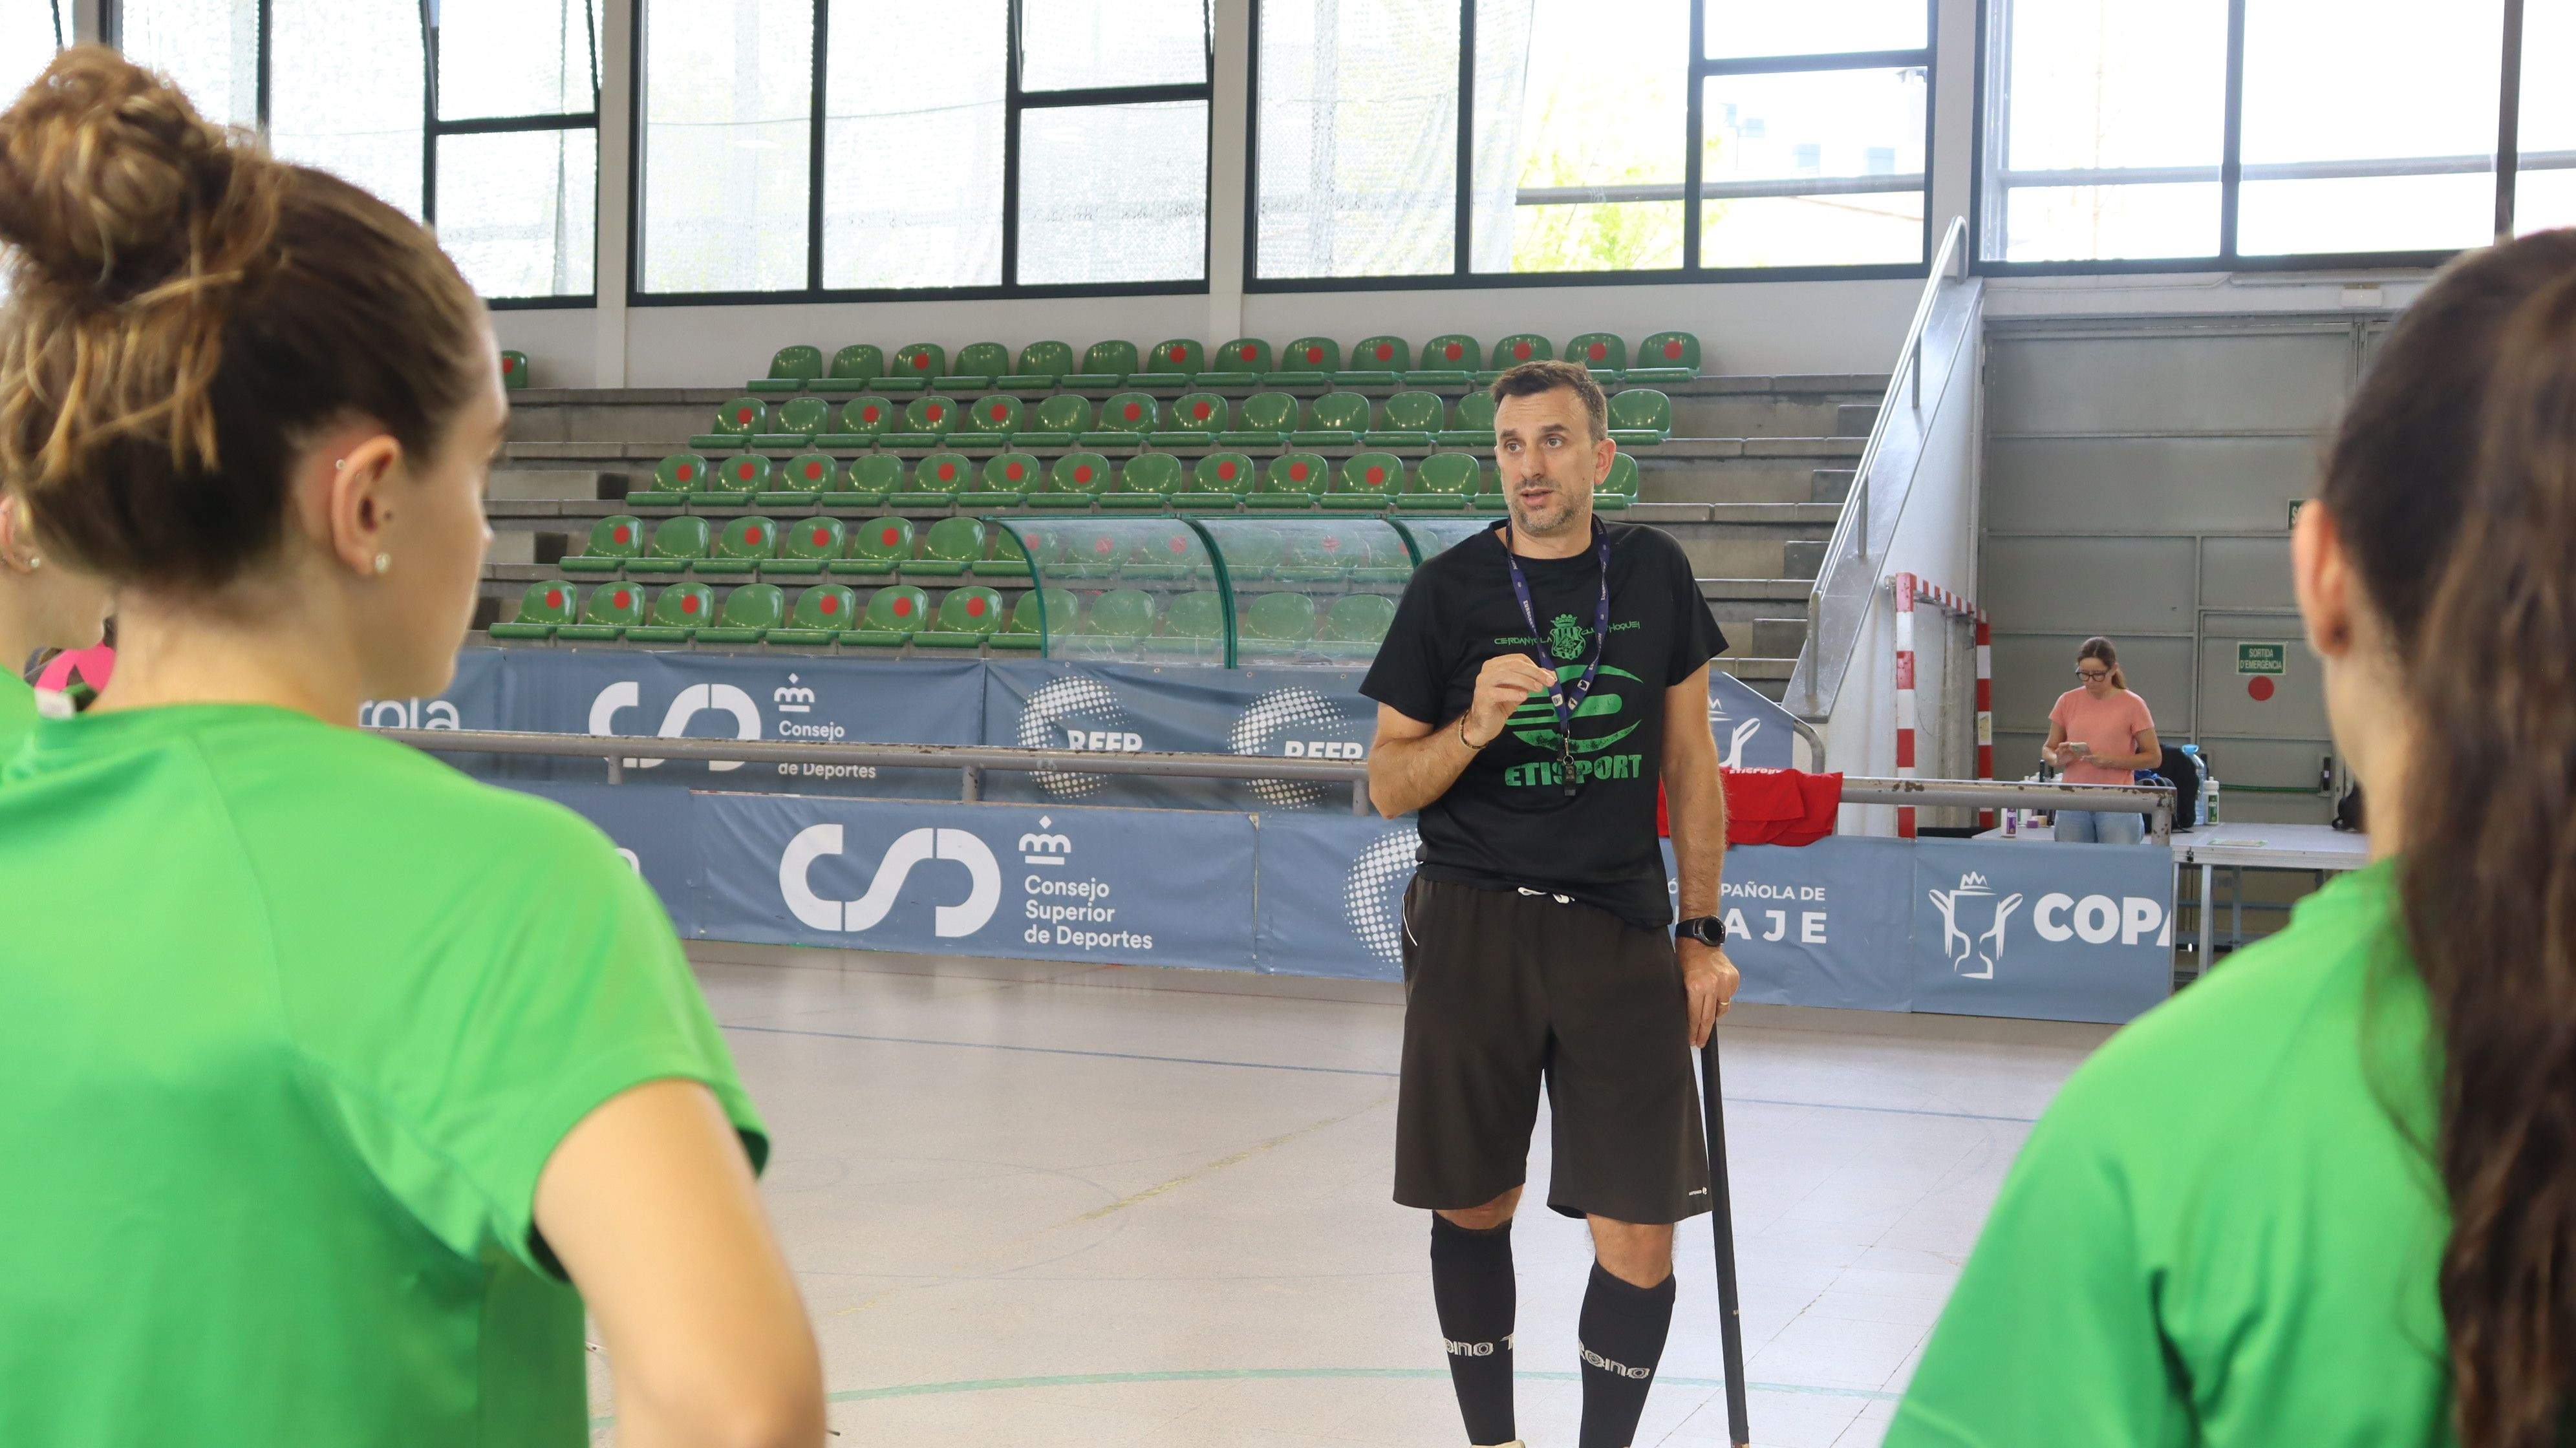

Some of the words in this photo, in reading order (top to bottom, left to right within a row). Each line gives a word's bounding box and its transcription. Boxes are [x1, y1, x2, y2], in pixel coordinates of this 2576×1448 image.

[1608, 621, 1640, 634] HOQUEI
[2249, 648, 2273, 657] SORTIDA
[778, 719, 845, 741] Consejo
[802, 763, 877, 780] Deportes
[1024, 875, 1110, 902] Consejo
[1800, 886, 1825, 901] DE
[1025, 899, 1115, 924] Superior
[1024, 924, 1050, 944] de
[1057, 926, 1153, 950] Deportes
